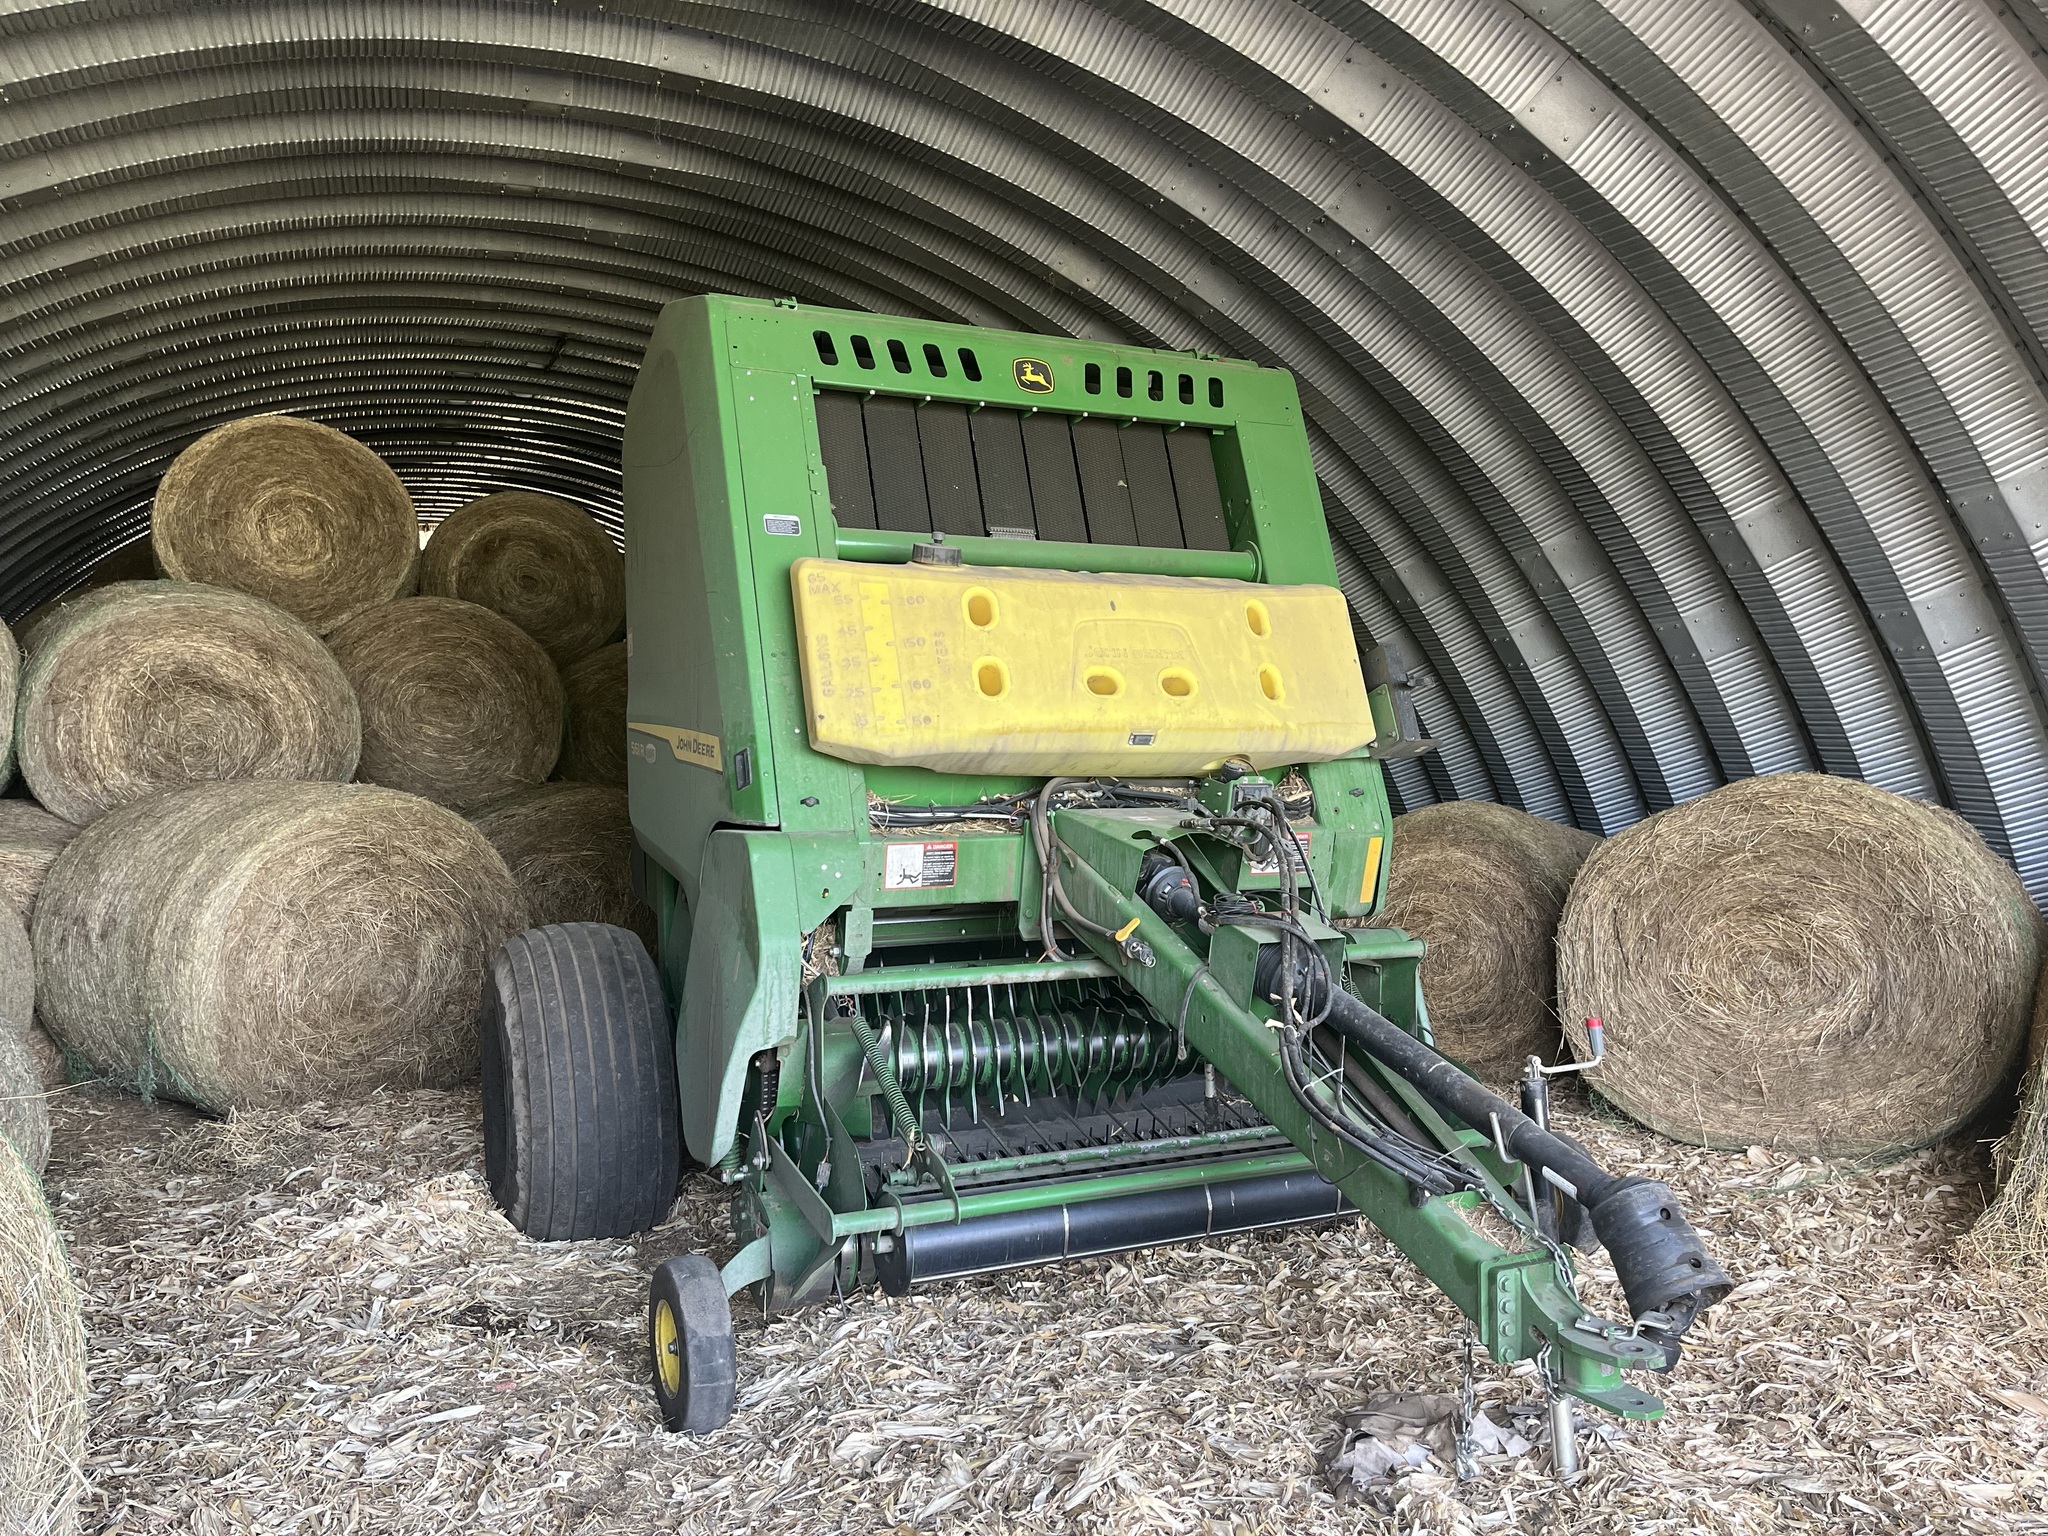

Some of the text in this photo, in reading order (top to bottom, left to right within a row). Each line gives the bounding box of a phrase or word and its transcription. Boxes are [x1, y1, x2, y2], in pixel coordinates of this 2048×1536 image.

[808, 581, 841, 595] MAX
[833, 594, 853, 606] 55
[897, 594, 925, 606] 200
[837, 624, 857, 636] 45
[903, 637, 926, 649] 150
[816, 633, 835, 698] GALLONS
[841, 656, 861, 670] 35
[845, 686, 865, 699] 25
[907, 678, 932, 693] 100
[911, 714, 932, 728] 50
[676, 735, 693, 753] JOHN
[693, 739, 715, 758] DEERE
